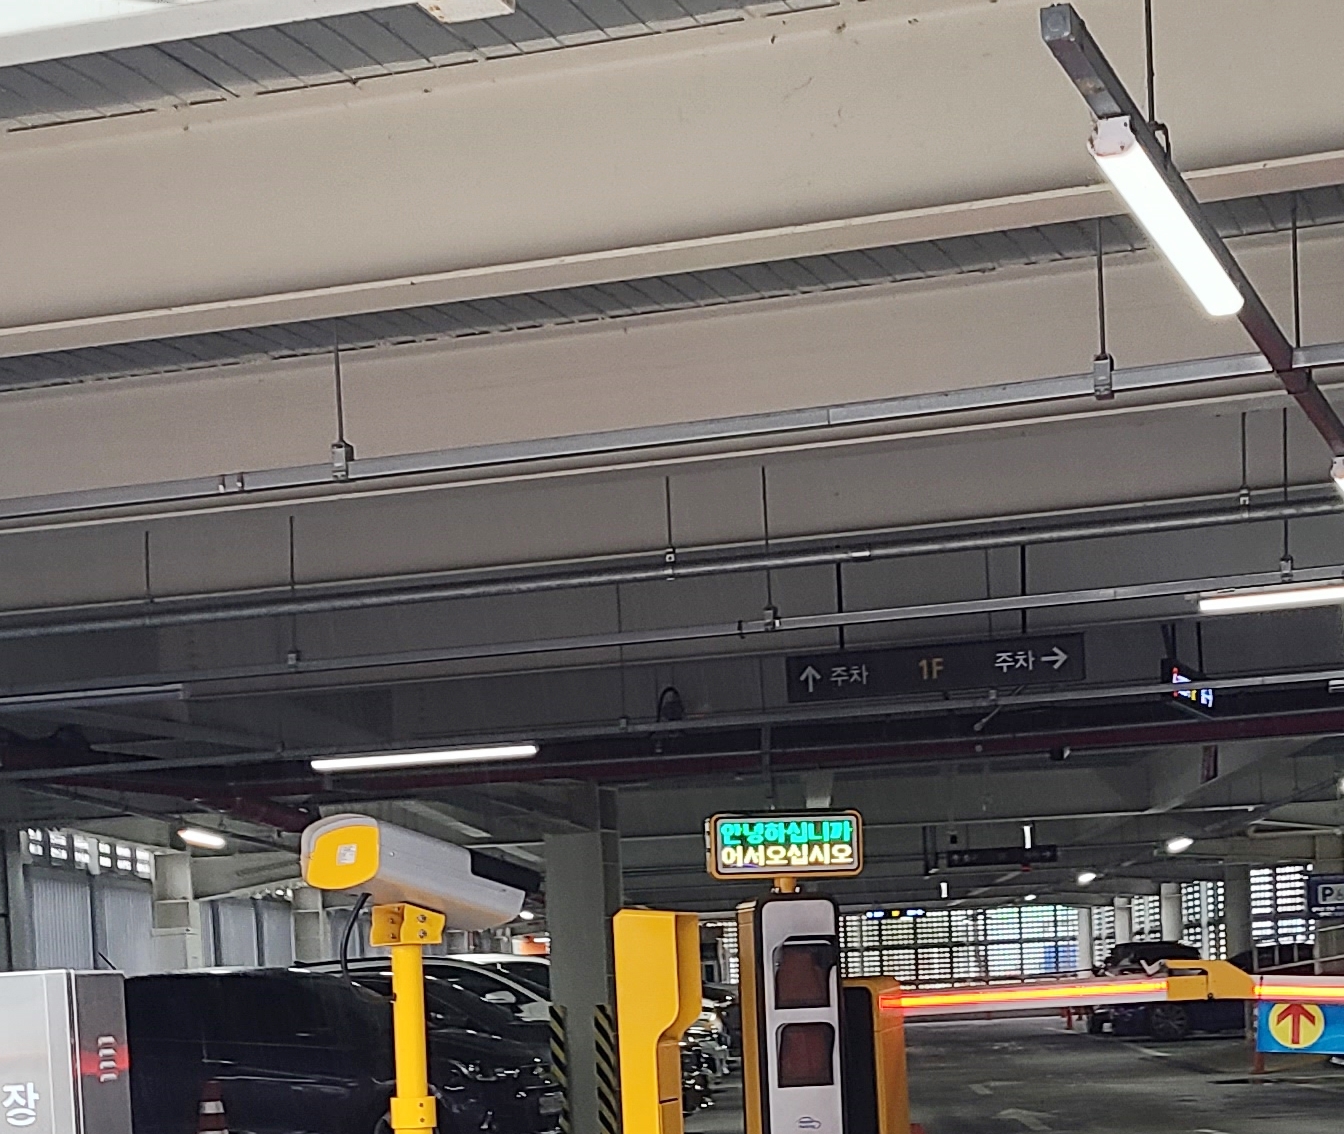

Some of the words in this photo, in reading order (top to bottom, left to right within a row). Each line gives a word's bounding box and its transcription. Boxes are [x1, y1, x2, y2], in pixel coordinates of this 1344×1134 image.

[829, 664, 869, 687] 주차
[918, 657, 944, 681] 1F
[994, 650, 1035, 673] 주차
[720, 820, 853, 845] 안녕하십니까
[721, 844, 854, 867] 어서오십시오
